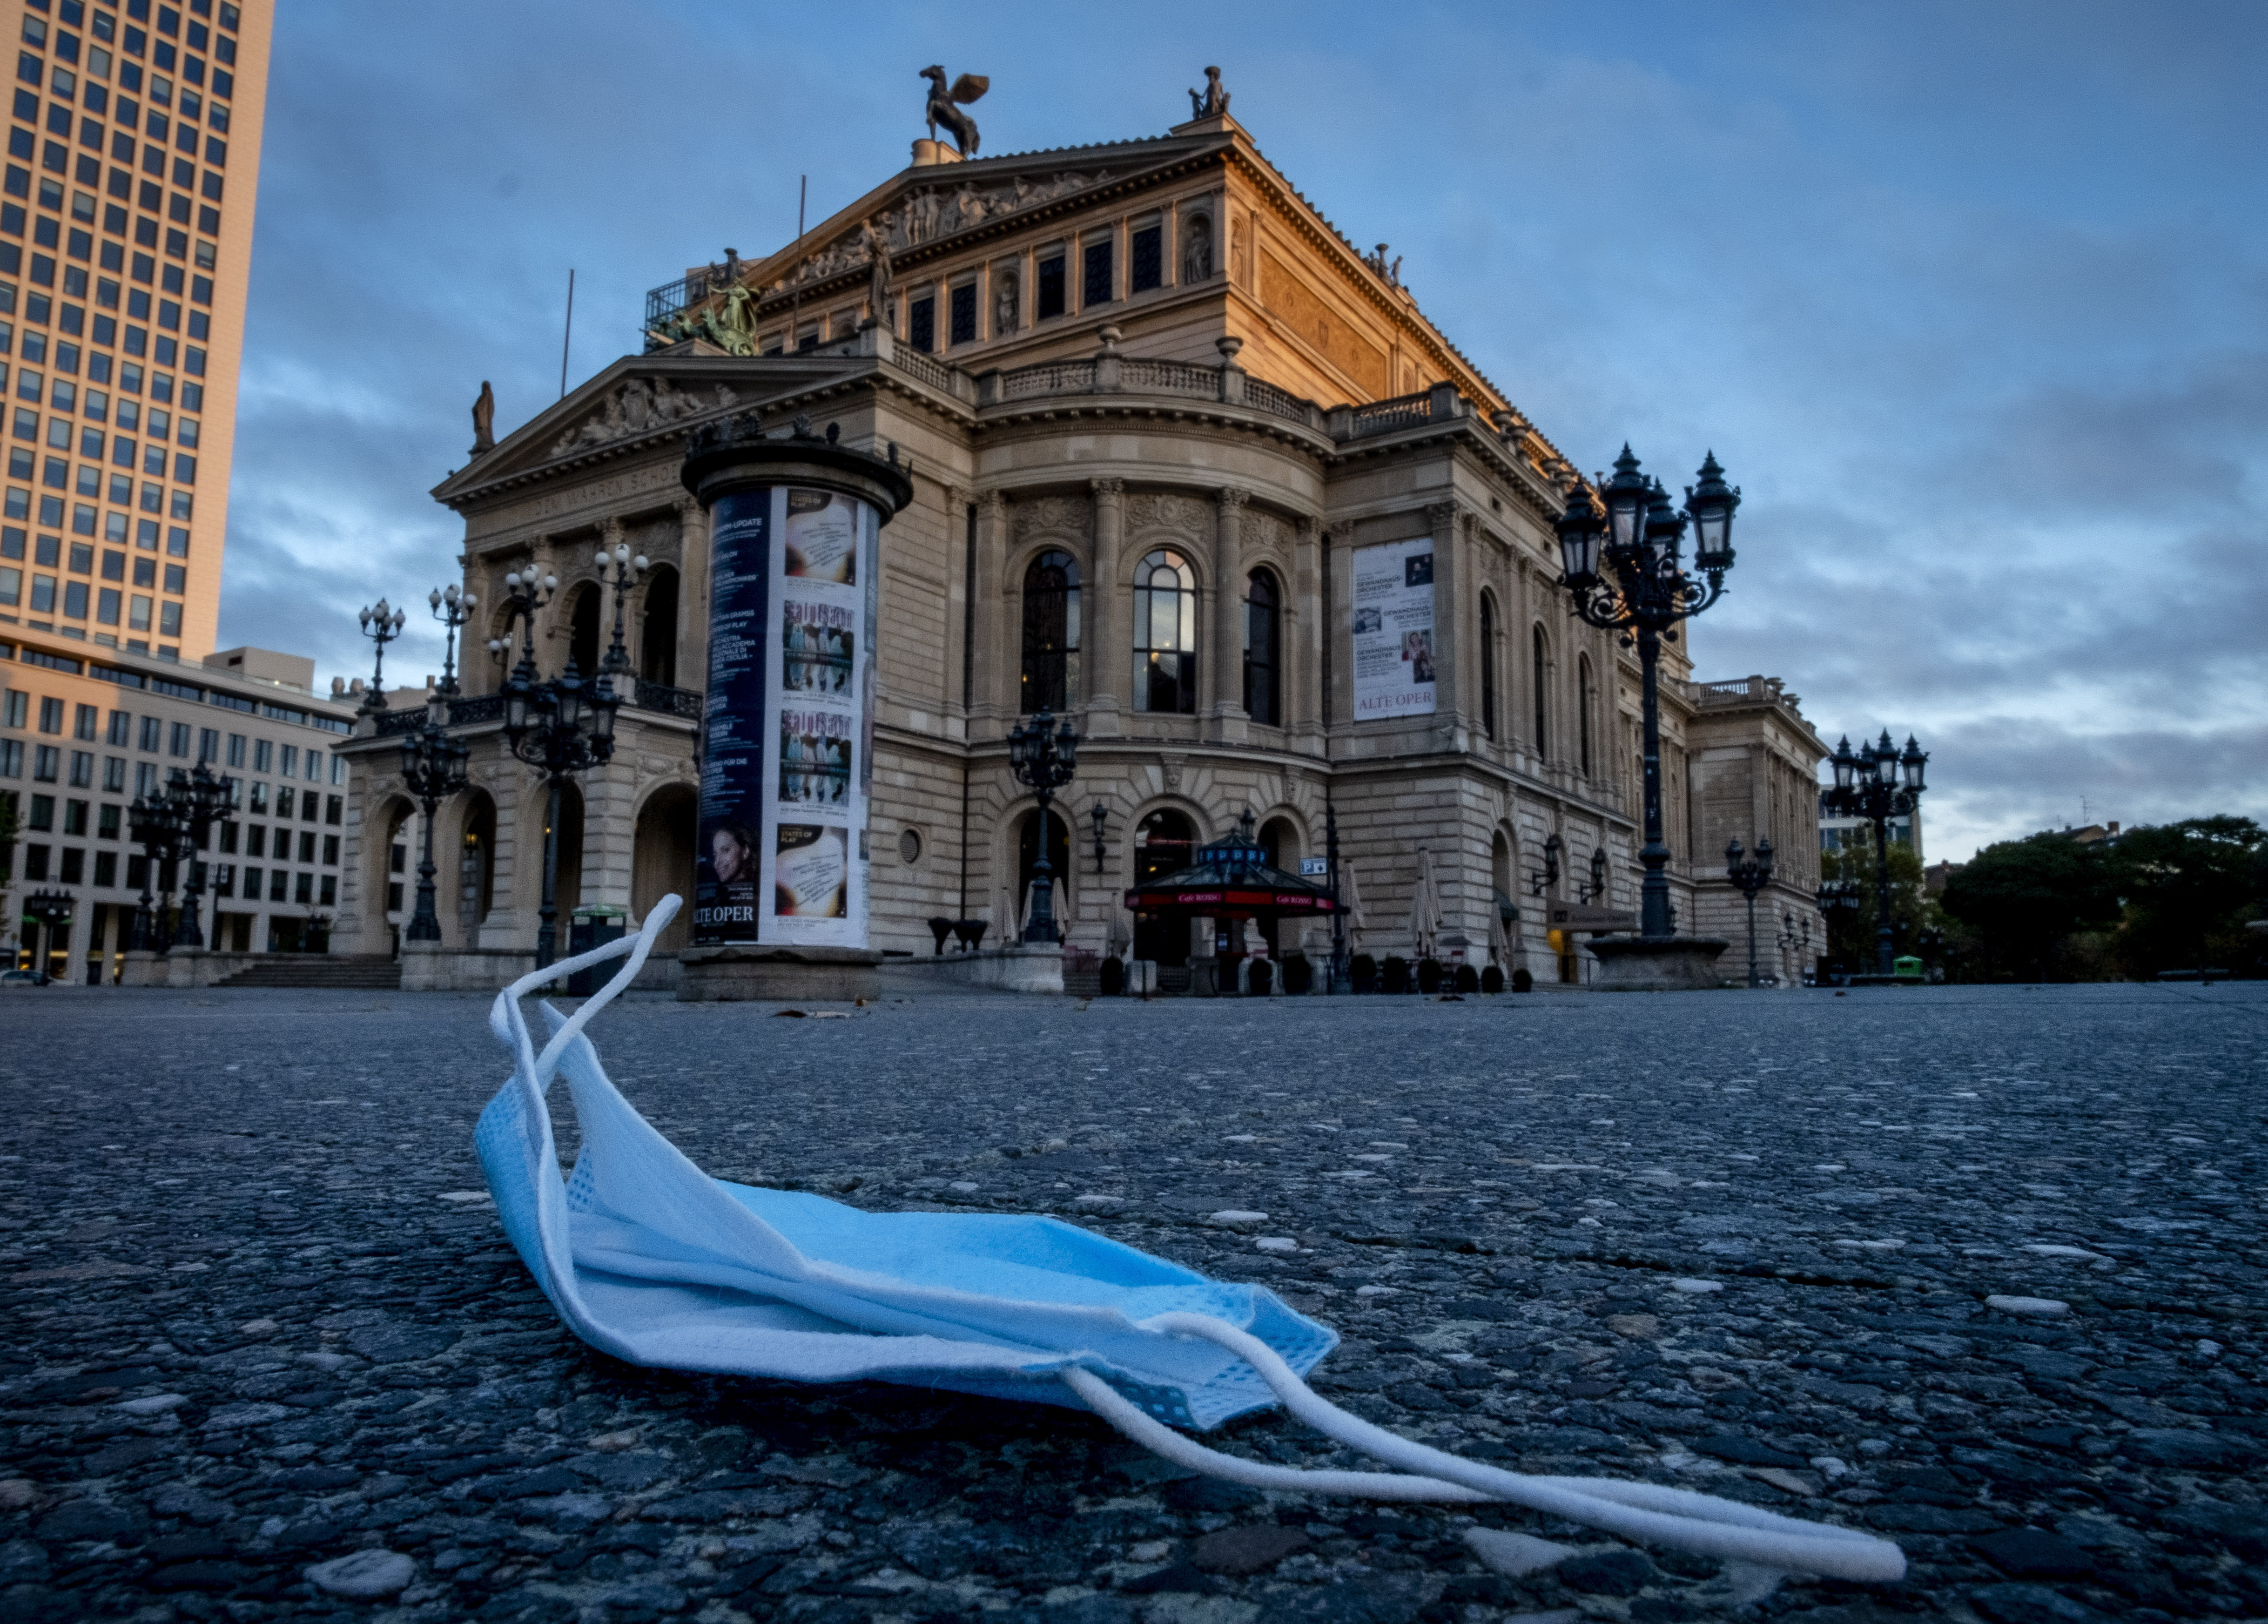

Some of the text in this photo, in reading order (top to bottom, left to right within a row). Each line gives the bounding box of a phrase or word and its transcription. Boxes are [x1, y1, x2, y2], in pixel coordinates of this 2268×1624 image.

[1356, 583, 1393, 594] ORCHESTER
[1393, 611, 1431, 621] ORCHESTER
[1357, 652, 1393, 661] ORCHESTER
[1359, 692, 1432, 711] ALTE OPER
[1304, 863, 1311, 872] P
[713, 906, 754, 922] OPER
